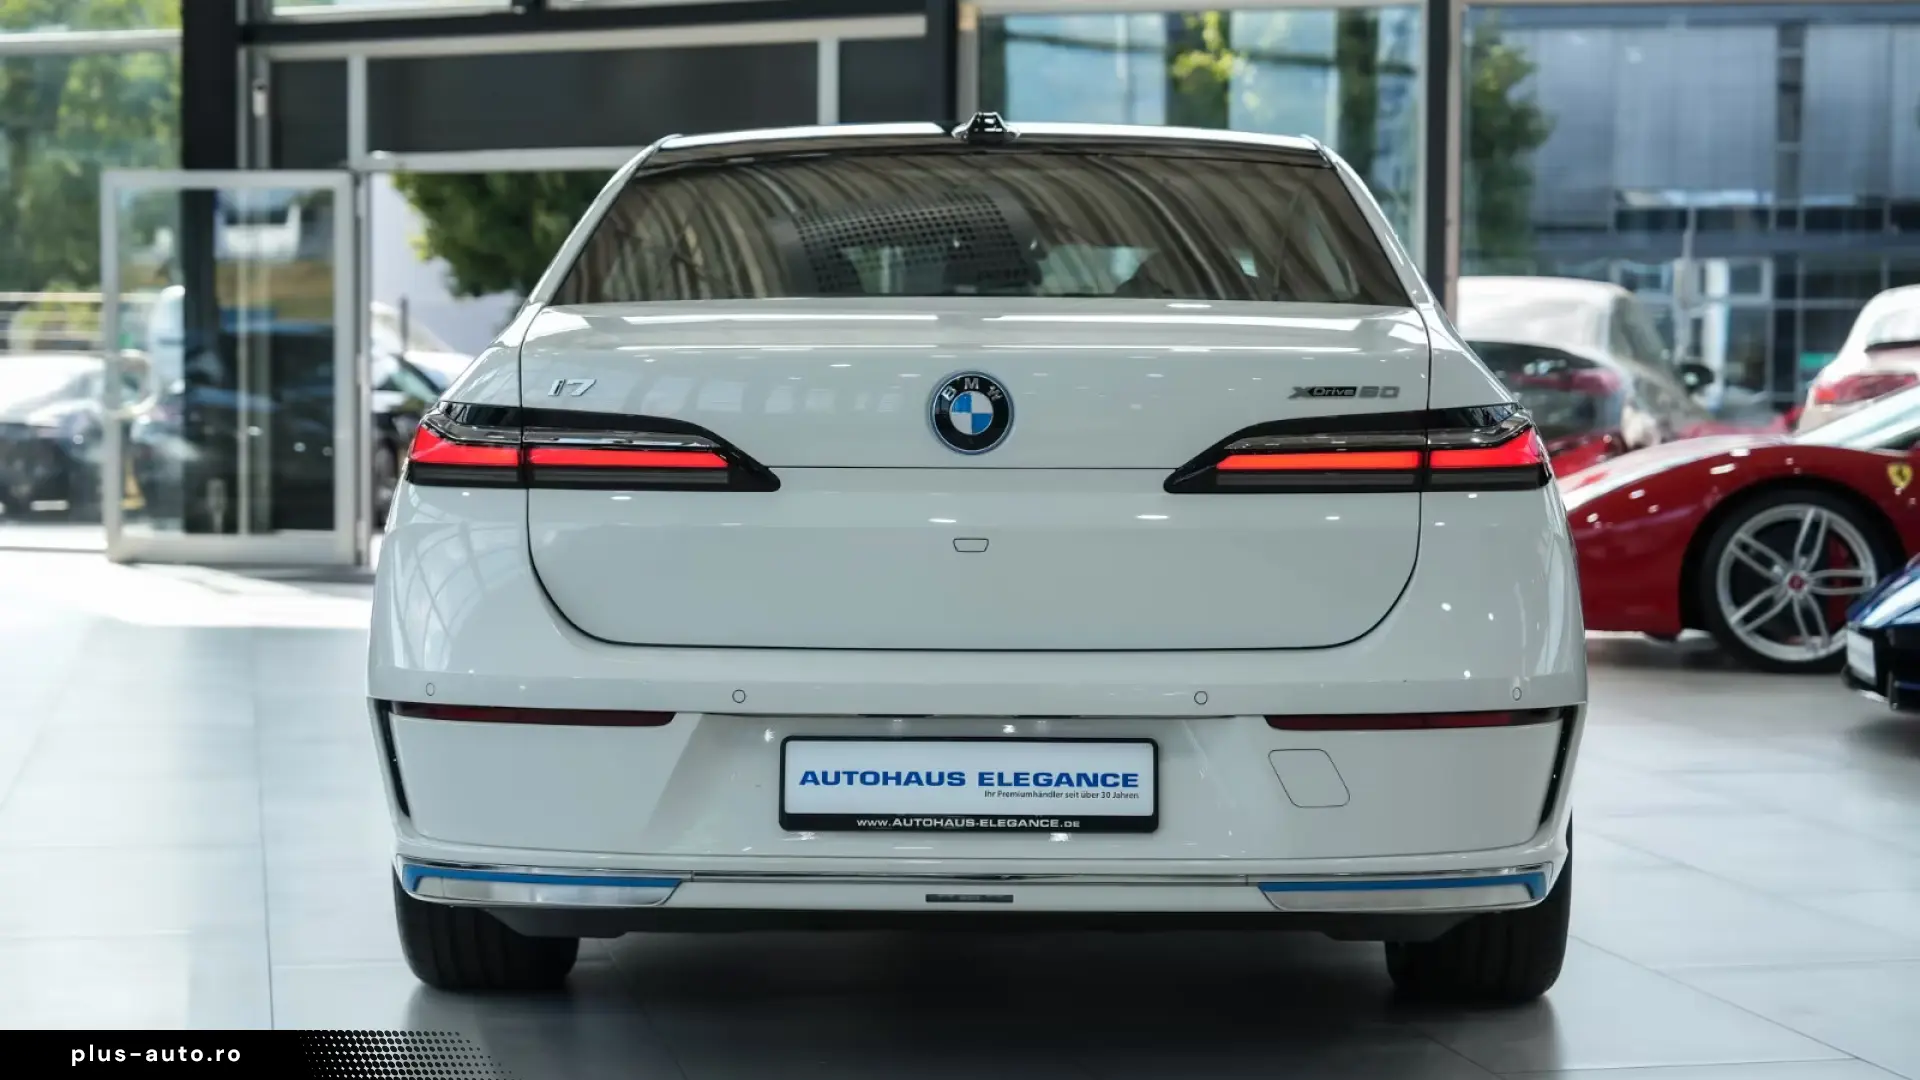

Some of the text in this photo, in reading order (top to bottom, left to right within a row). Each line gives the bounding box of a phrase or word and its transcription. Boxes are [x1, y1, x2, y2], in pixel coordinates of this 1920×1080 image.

[941, 377, 1004, 402] BMW
[799, 770, 1140, 788] AUTOHAUS ELEGANCE
[984, 790, 996, 798] Ihr
[998, 790, 1064, 799] Premiumhändler
[1065, 791, 1079, 799] seit
[1080, 791, 1100, 799] über
[1101, 791, 1111, 799] 30
[856, 817, 1081, 828] www.AUTOHAUS-ELEGANCE.DE
